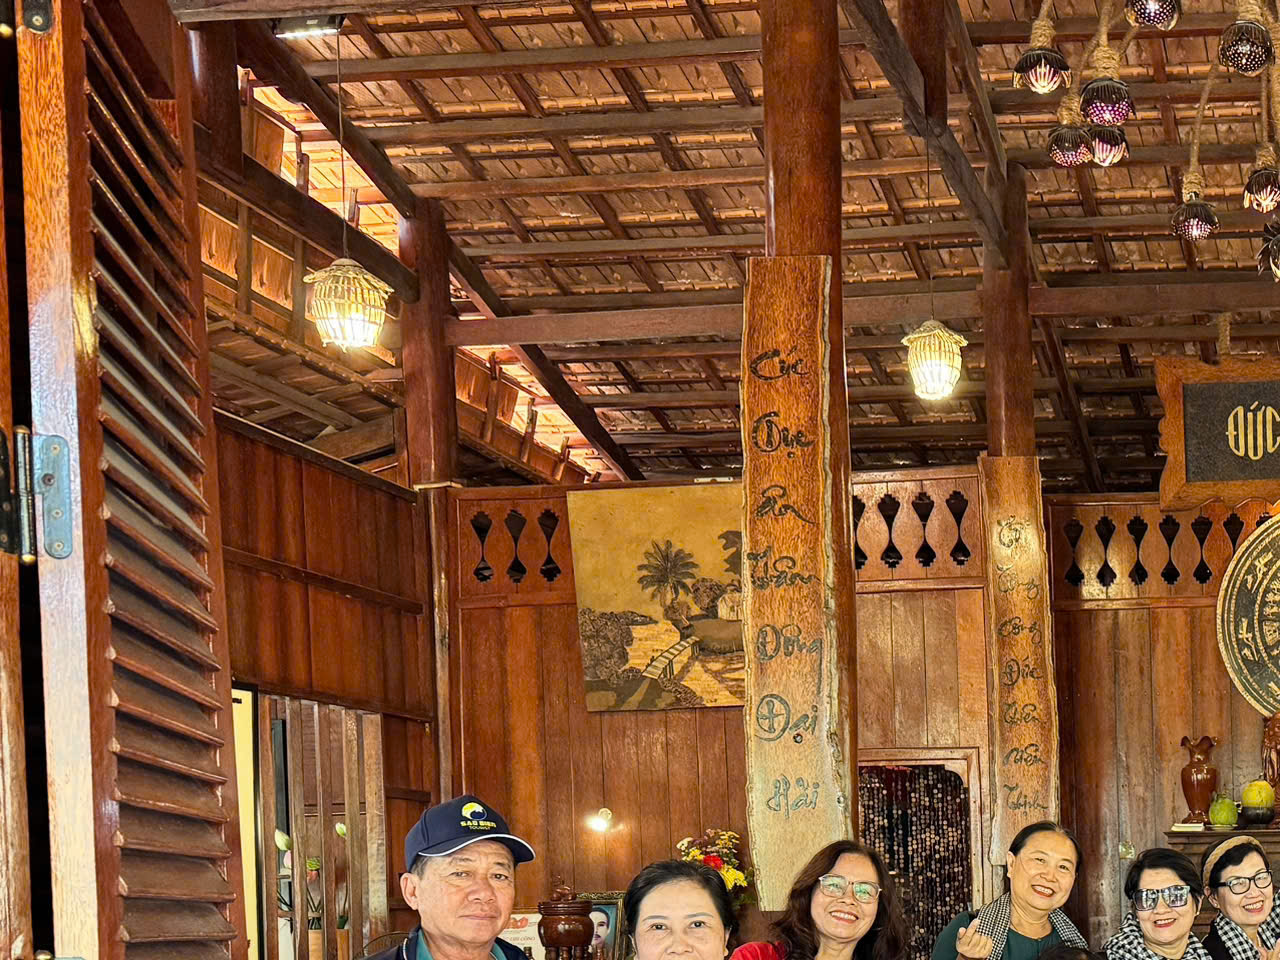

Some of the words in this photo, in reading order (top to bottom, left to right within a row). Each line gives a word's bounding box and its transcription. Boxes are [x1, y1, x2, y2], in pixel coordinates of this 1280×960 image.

[1003, 656, 1044, 686] Đức
[755, 693, 818, 744] Đại
[766, 774, 820, 819] Hải
